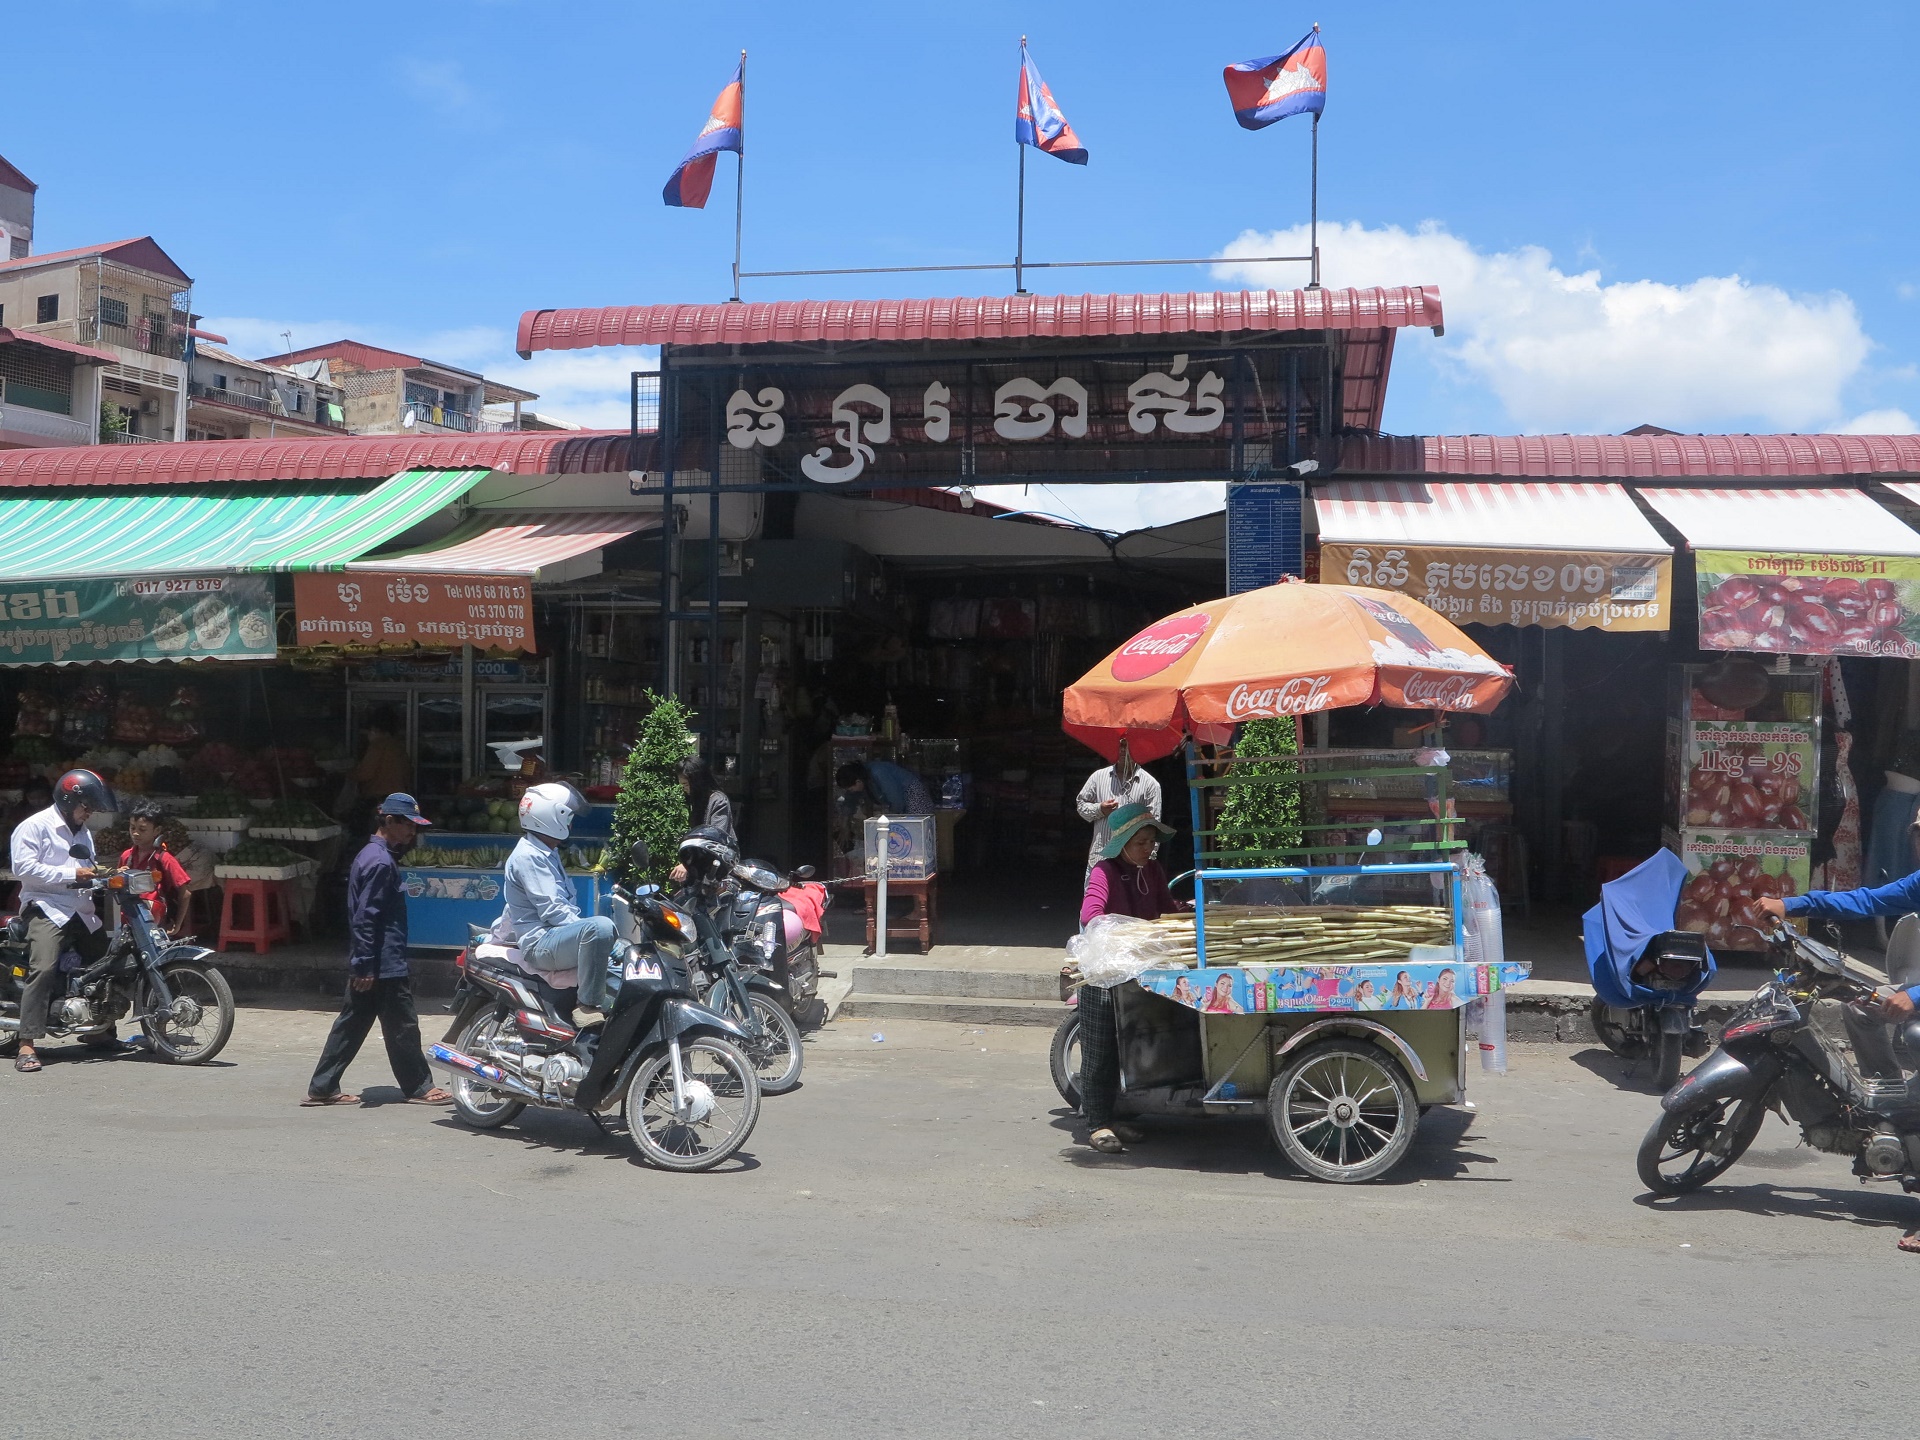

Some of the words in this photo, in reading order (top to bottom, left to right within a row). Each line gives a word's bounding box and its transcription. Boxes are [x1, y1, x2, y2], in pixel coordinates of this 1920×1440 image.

[136, 579, 160, 594] 017
[166, 579, 191, 593] 927
[196, 578, 222, 591] 879
[444, 584, 463, 599] Tel:
[464, 584, 482, 599] 015
[483, 585, 498, 599] 68
[499, 585, 511, 600] 78
[468, 604, 486, 619] 015
[488, 604, 506, 619] 370
[508, 605, 524, 620] 678
[1479, 594, 1504, 614] និង
[381, 616, 406, 634] និង
[1122, 632, 1200, 656] Coca-Cola
[1883, 640, 1899, 655] 61
[1901, 641, 1917, 656] 61
[1226, 675, 1332, 720] Coca-Cola
[1403, 671, 1478, 710] Coca-Cola
[1699, 750, 1744, 778] 1kg
[1773, 751, 1803, 776] 9$
